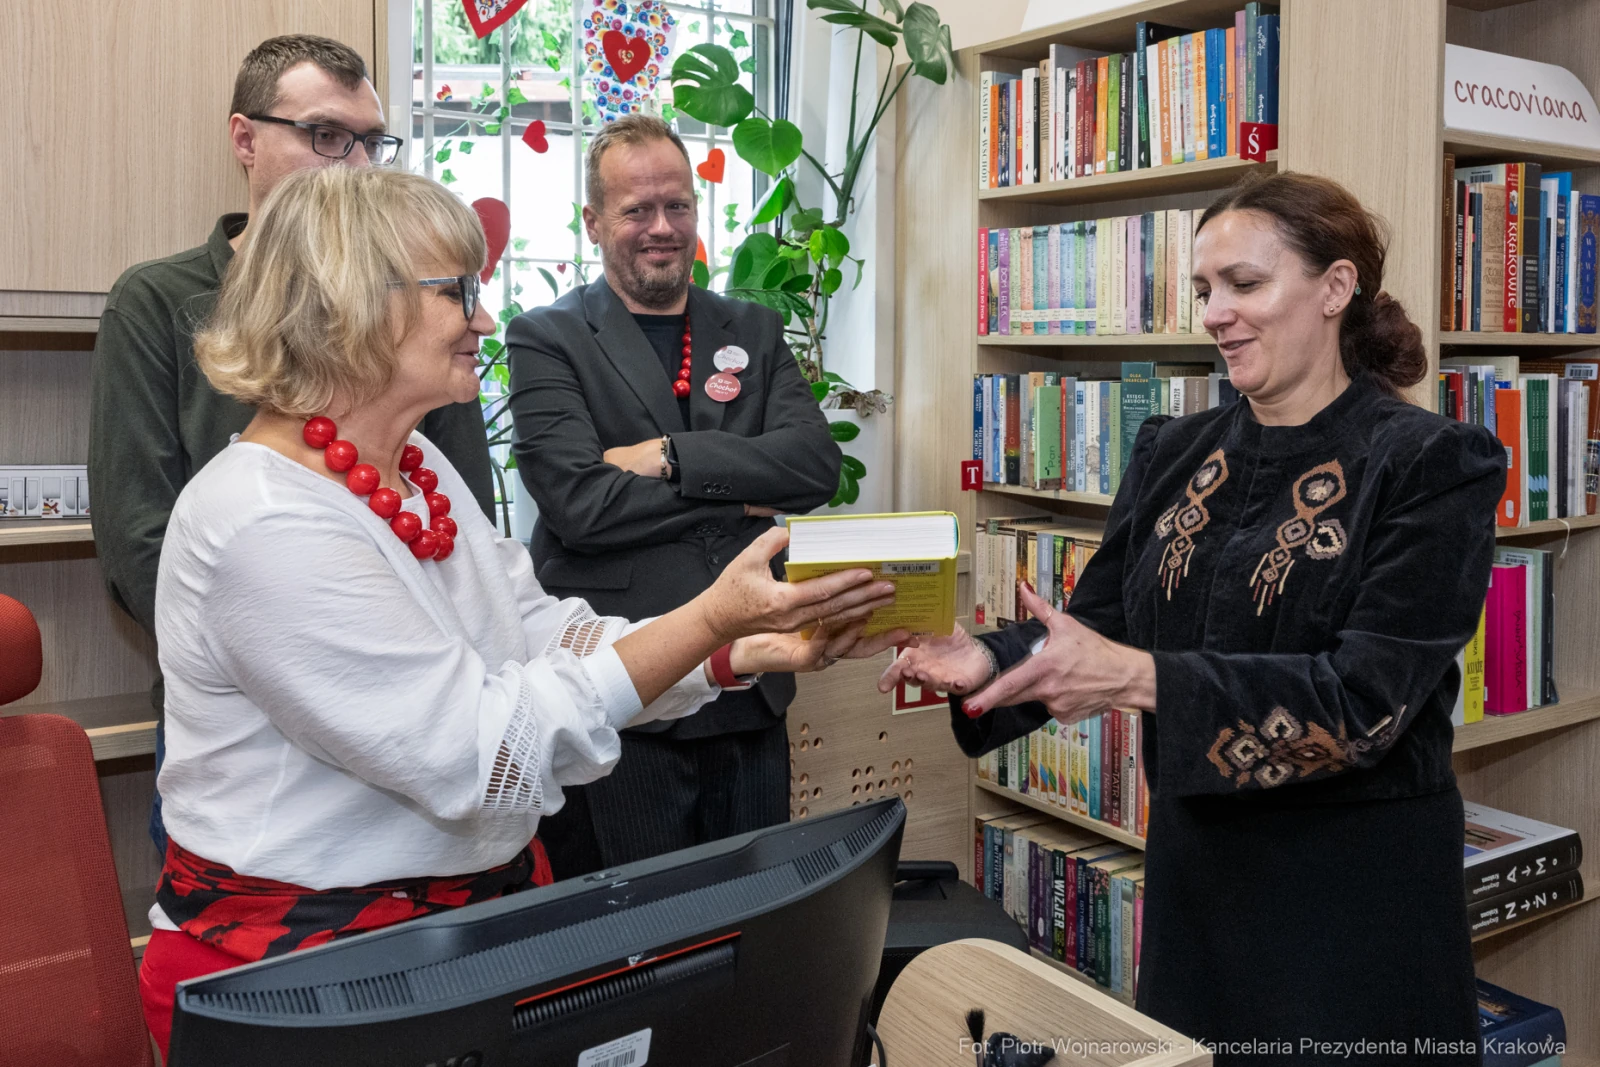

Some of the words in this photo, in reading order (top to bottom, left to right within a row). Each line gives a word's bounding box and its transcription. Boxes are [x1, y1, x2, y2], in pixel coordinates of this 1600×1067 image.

[1041, 76, 1049, 107] ANDRZEJ
[1454, 80, 1587, 123] cracoviana
[1041, 110, 1049, 141] STASIUK
[1248, 128, 1260, 155] Ś
[982, 139, 990, 183] WSCHÓD
[967, 466, 979, 485] T
[1054, 880, 1065, 929] WIZJER
